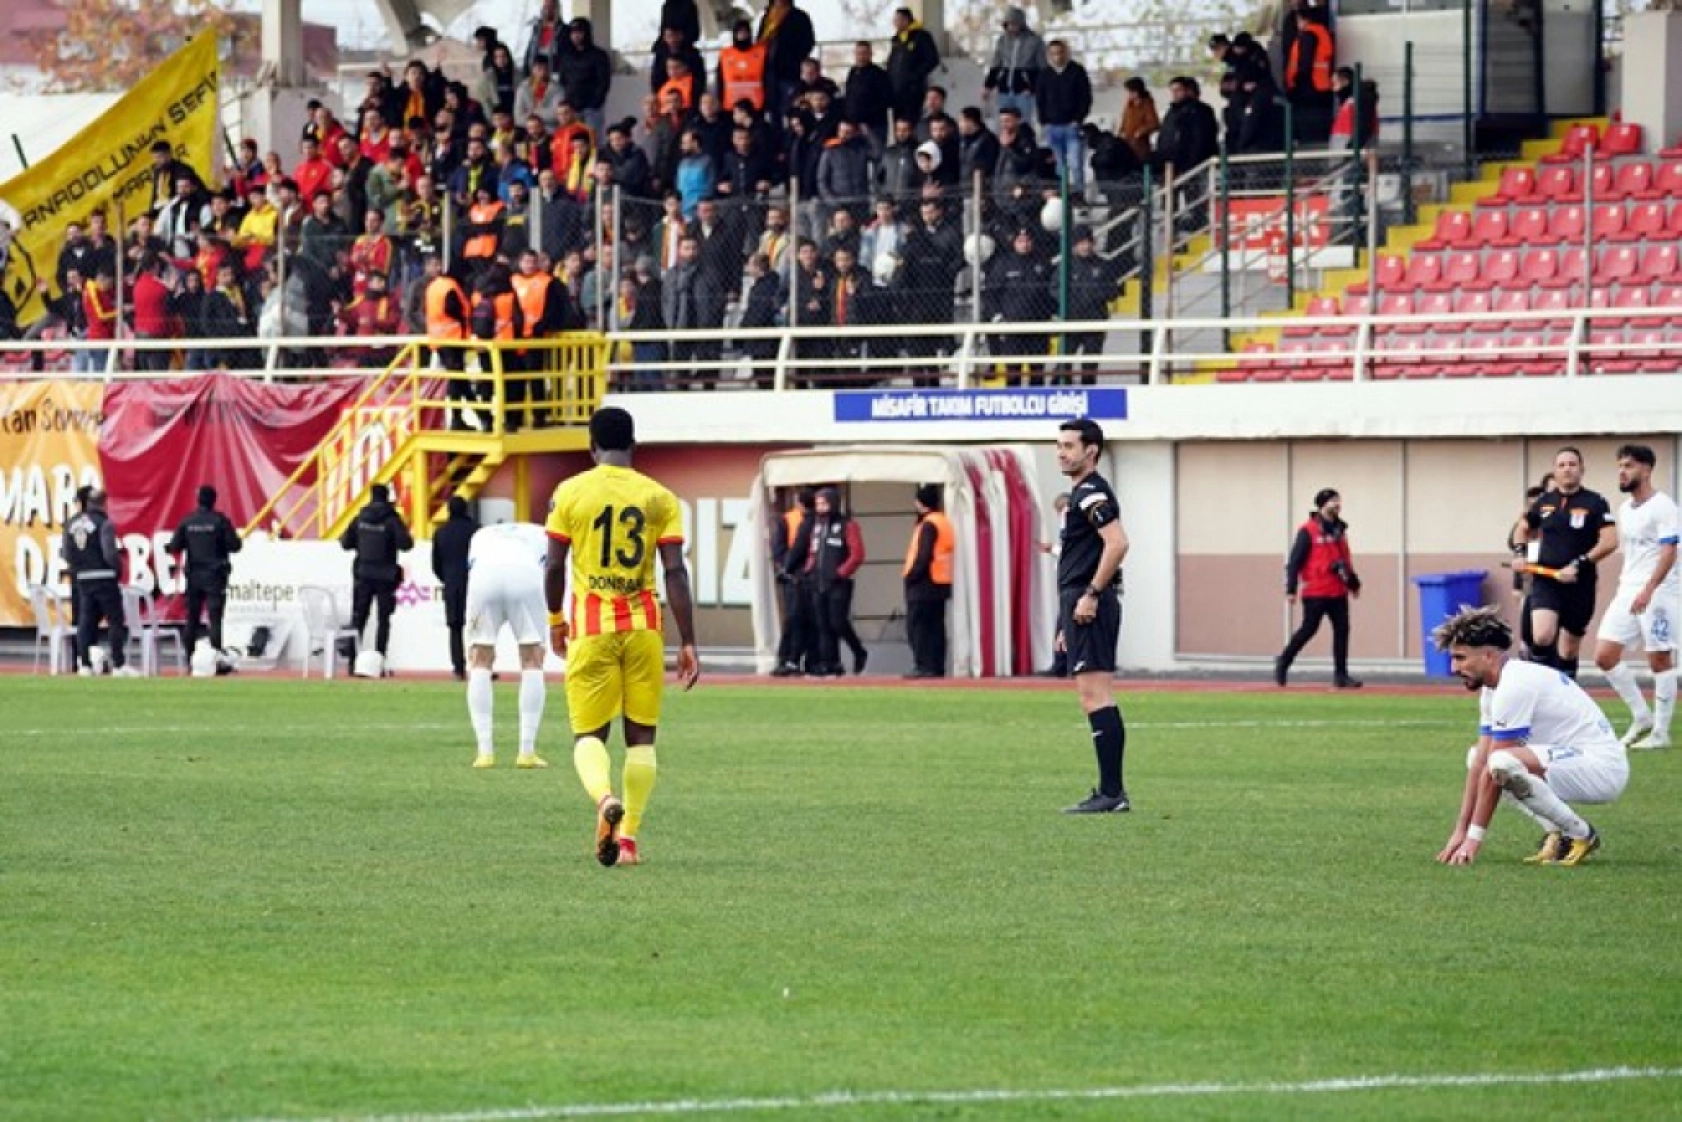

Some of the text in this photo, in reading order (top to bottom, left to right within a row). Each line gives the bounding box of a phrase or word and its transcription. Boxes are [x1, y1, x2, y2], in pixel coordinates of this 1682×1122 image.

[929, 395, 971, 416] TAKIM
[975, 394, 1046, 416] FUTBOLCU
[593, 504, 646, 569] 13
